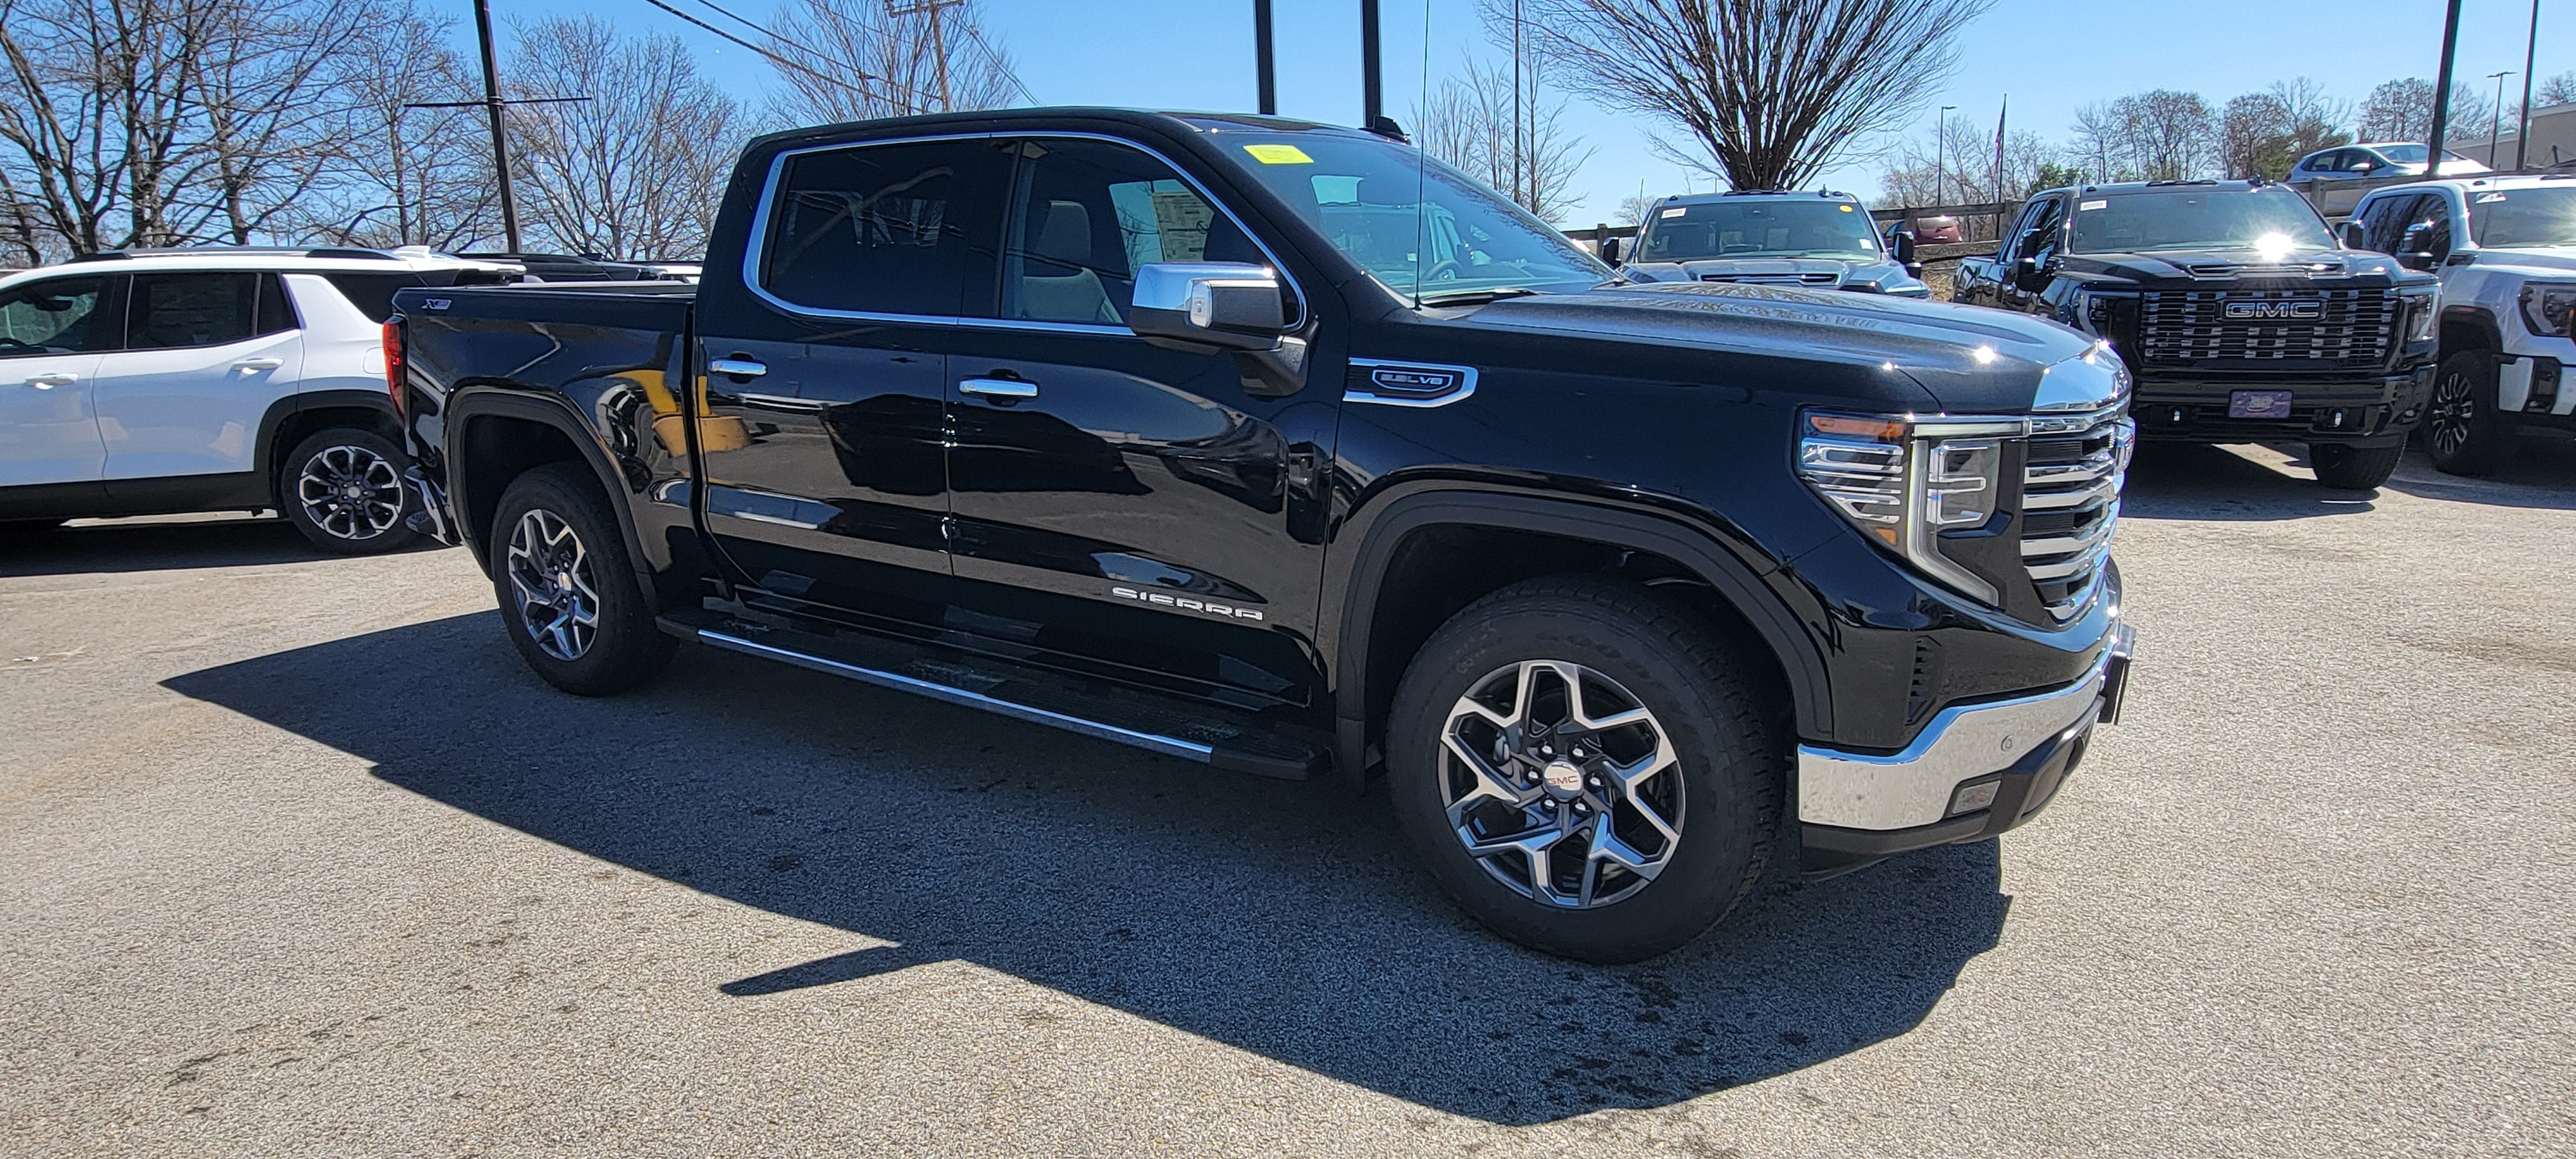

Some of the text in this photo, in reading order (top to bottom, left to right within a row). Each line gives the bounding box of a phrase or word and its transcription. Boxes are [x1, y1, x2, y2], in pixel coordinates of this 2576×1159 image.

[2226, 302, 2320, 317] GMC
[1112, 587, 1263, 621] SIERRA
[1546, 775, 1578, 785] GMC
